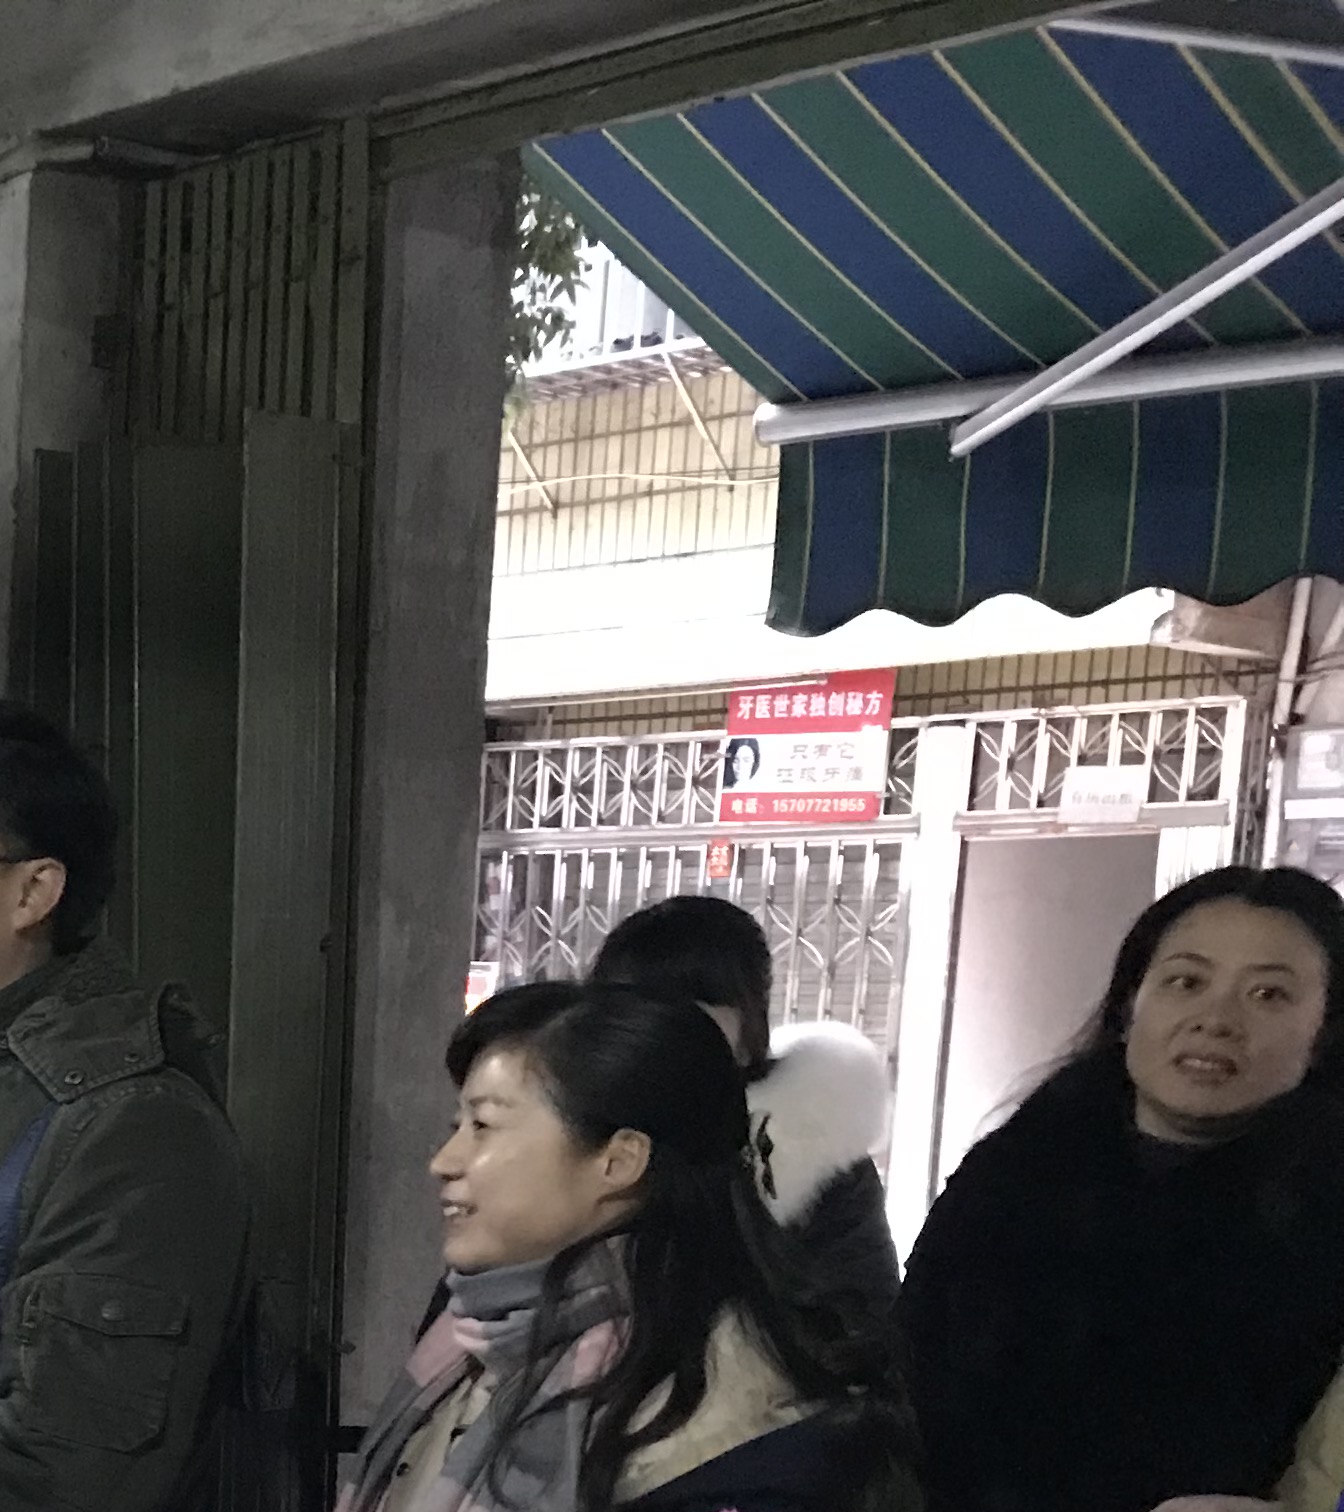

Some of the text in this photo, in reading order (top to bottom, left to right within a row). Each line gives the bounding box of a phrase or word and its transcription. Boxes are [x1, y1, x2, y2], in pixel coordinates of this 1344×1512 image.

[737, 690, 884, 719] 牙医世家独创秘方
[789, 741, 856, 760] 只有它
